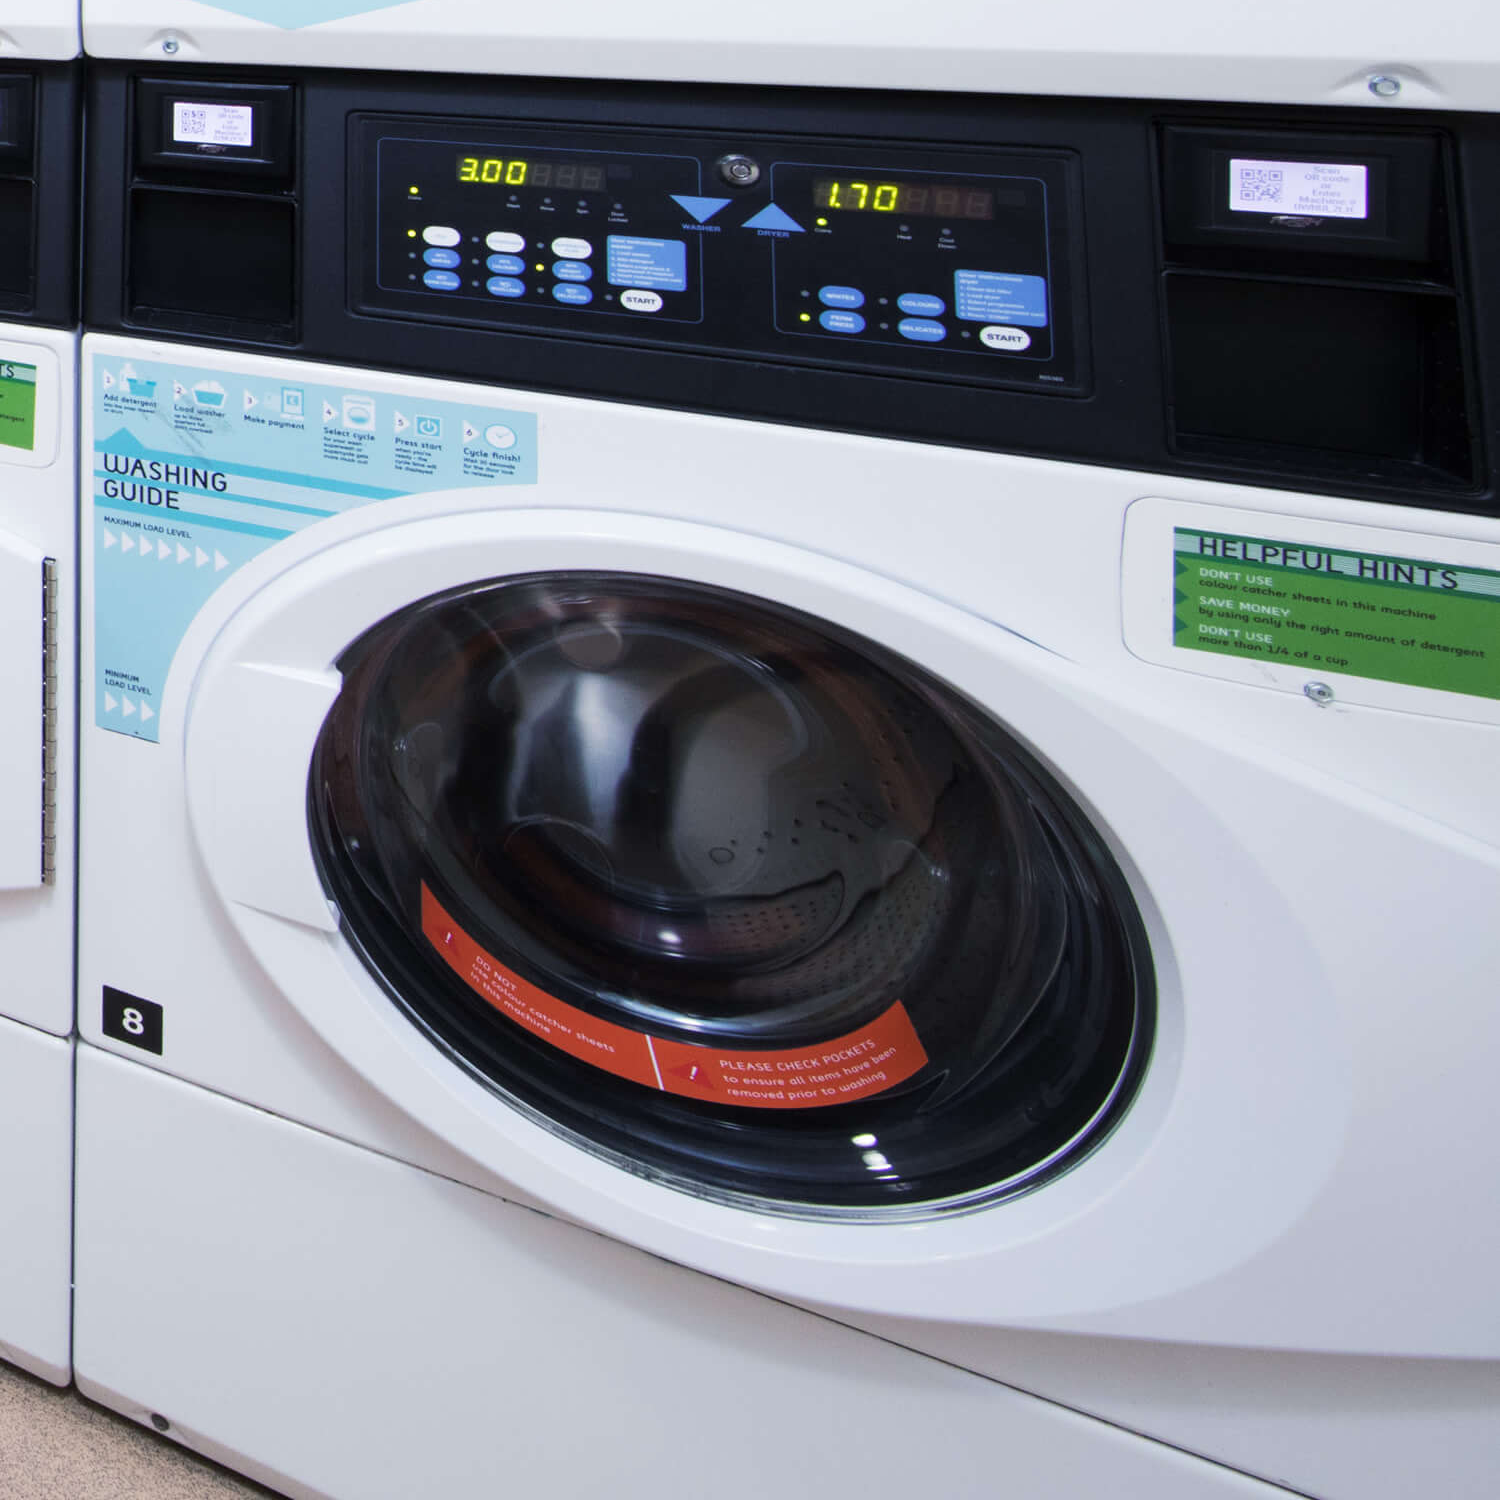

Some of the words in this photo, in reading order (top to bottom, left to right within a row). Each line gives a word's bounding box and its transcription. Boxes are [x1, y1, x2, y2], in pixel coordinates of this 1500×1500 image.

[459, 158, 527, 186] 3.00
[829, 182, 898, 211] 1.70
[626, 296, 655, 305] START
[987, 333, 1022, 343] START
[104, 453, 227, 492] WASHING
[103, 479, 179, 510] GUIDE
[104, 516, 141, 530] MAXIMUM
[143, 523, 164, 533] LOAD
[166, 527, 191, 539] LEVEL
[1200, 536, 1344, 574] HELPFUL
[1359, 558, 1458, 590] HINTS
[1200, 567, 1240, 581] DON'T
[1247, 575, 1272, 586] USE
[1200, 596, 1233, 609] SAVE
[1240, 601, 1290, 617] MONEY
[1199, 624, 1240, 637] DON'T
[1247, 632, 1272, 644] USE
[476, 956, 490, 972] DO
[493, 969, 516, 991] NOT
[122, 1007, 144, 1035] 8
[719, 1060, 772, 1072] PLEASE
[777, 1058, 820, 1072] CHECK
[823, 1039, 876, 1065] POCKETS
[724, 1076, 739, 1084] to
[743, 1078, 784, 1086] ensure
[789, 1077, 805, 1085] all
[808, 1071, 841, 1083] items
[844, 1061, 870, 1076] have
[871, 1047, 896, 1065] been
[728, 1087, 784, 1100] removed
[788, 1089, 818, 1101] prior
[822, 1086, 835, 1096] to
[840, 1071, 886, 1092] washing
